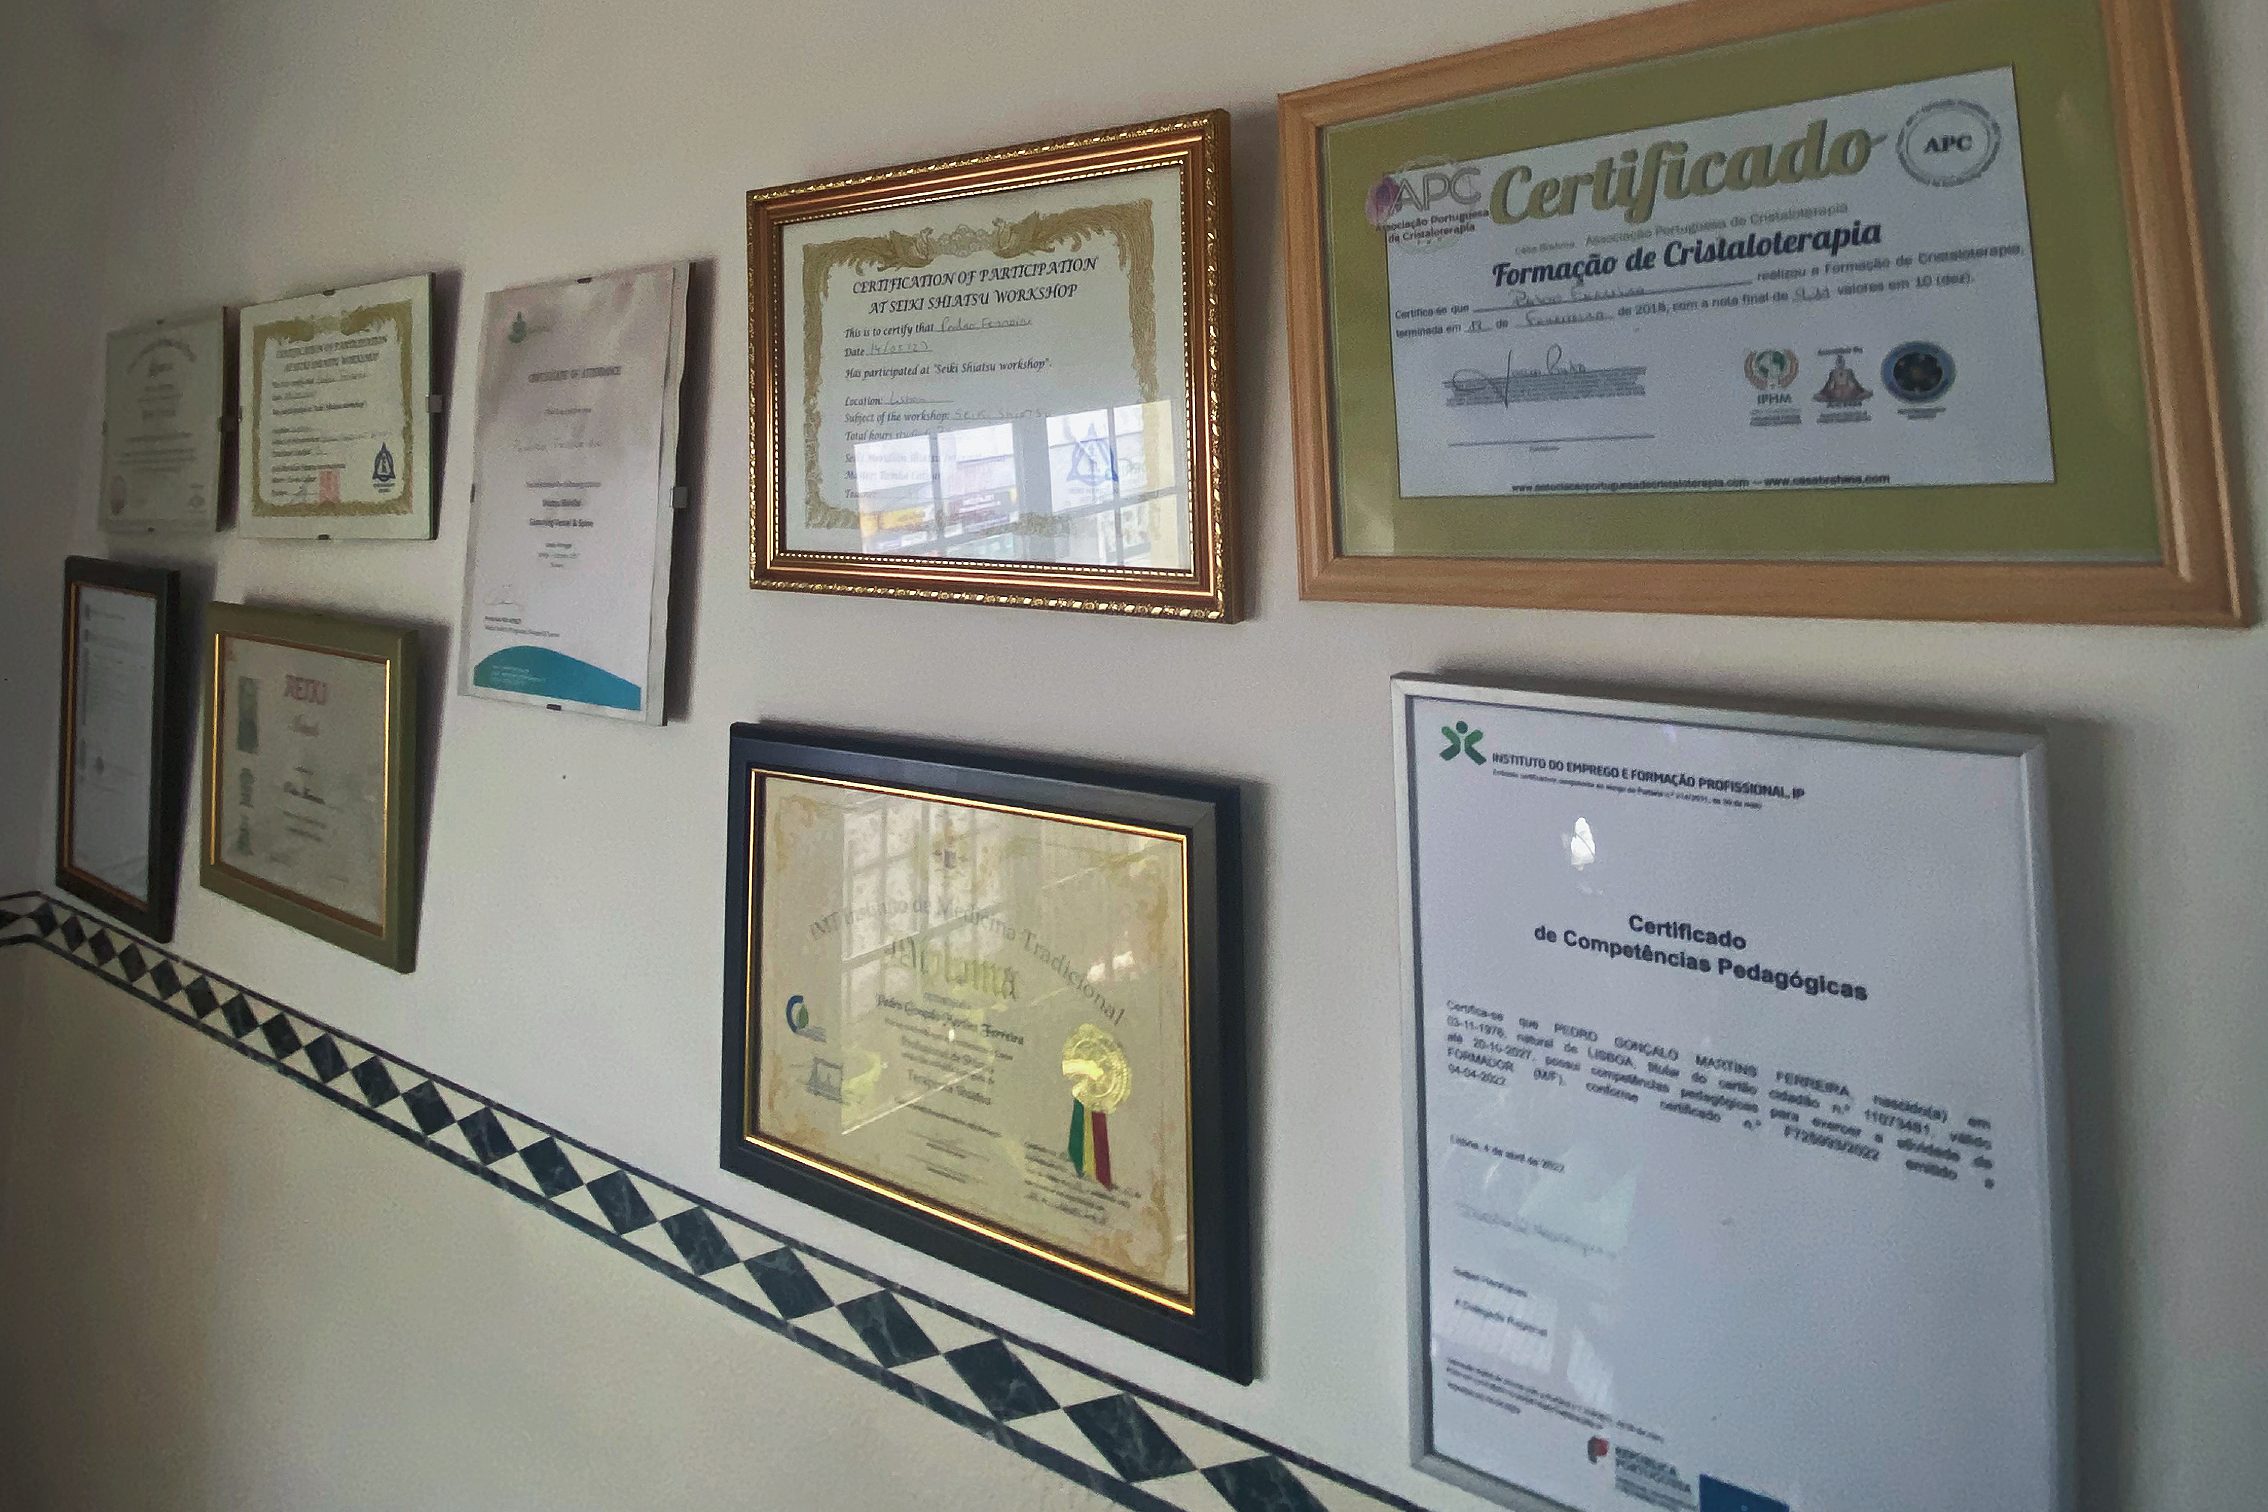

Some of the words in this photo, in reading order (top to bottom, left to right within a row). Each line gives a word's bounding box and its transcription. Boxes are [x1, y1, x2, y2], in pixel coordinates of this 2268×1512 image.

[1923, 134, 1973, 153] APC
[1489, 119, 1888, 225] Certificado
[1393, 166, 1481, 213] APC
[1492, 252, 1618, 287] Formação
[1625, 247, 1656, 271] de
[1663, 220, 1882, 268] Cristaloterapia
[852, 272, 957, 294] CERTIFICATION
[957, 271, 977, 286] OF
[979, 256, 1099, 282] PARTICIPATION
[868, 302, 887, 314] AT
[889, 296, 924, 313] SEIKI
[927, 293, 990, 311] SHIATSU
[995, 283, 1078, 303] WORKSHOP
[845, 328, 862, 338] This
[863, 328, 870, 337] is
[872, 328, 882, 337] to
[883, 324, 913, 338] certify
[915, 323, 935, 333] that
[844, 347, 865, 357] Date
[845, 369, 862, 379] Has
[863, 366, 918, 381] participated
[920, 366, 930, 376] at
[961, 361, 996, 373] Shiatsu
[844, 396, 883, 407] Location:
[844, 412, 875, 424] Subject
[876, 411, 886, 423] of
[887, 411, 902, 422] the
[844, 431, 867, 441] Total
[868, 430, 892, 441] hours
[1492, 752, 1546, 768] INSTITUTO
[1548, 759, 1564, 772] DO
[1566, 761, 1619, 778] EMPREGO
[1622, 767, 1628, 780] E
[1631, 768, 1695, 788] FORMAÇÃO
[1628, 913, 1748, 951] Certificado
[1534, 925, 1557, 943] de
[1563, 929, 1712, 973] Competências
[1717, 957, 1868, 1001] Pedagógicas
[1554, 1022, 1598, 1042] PEDRO
